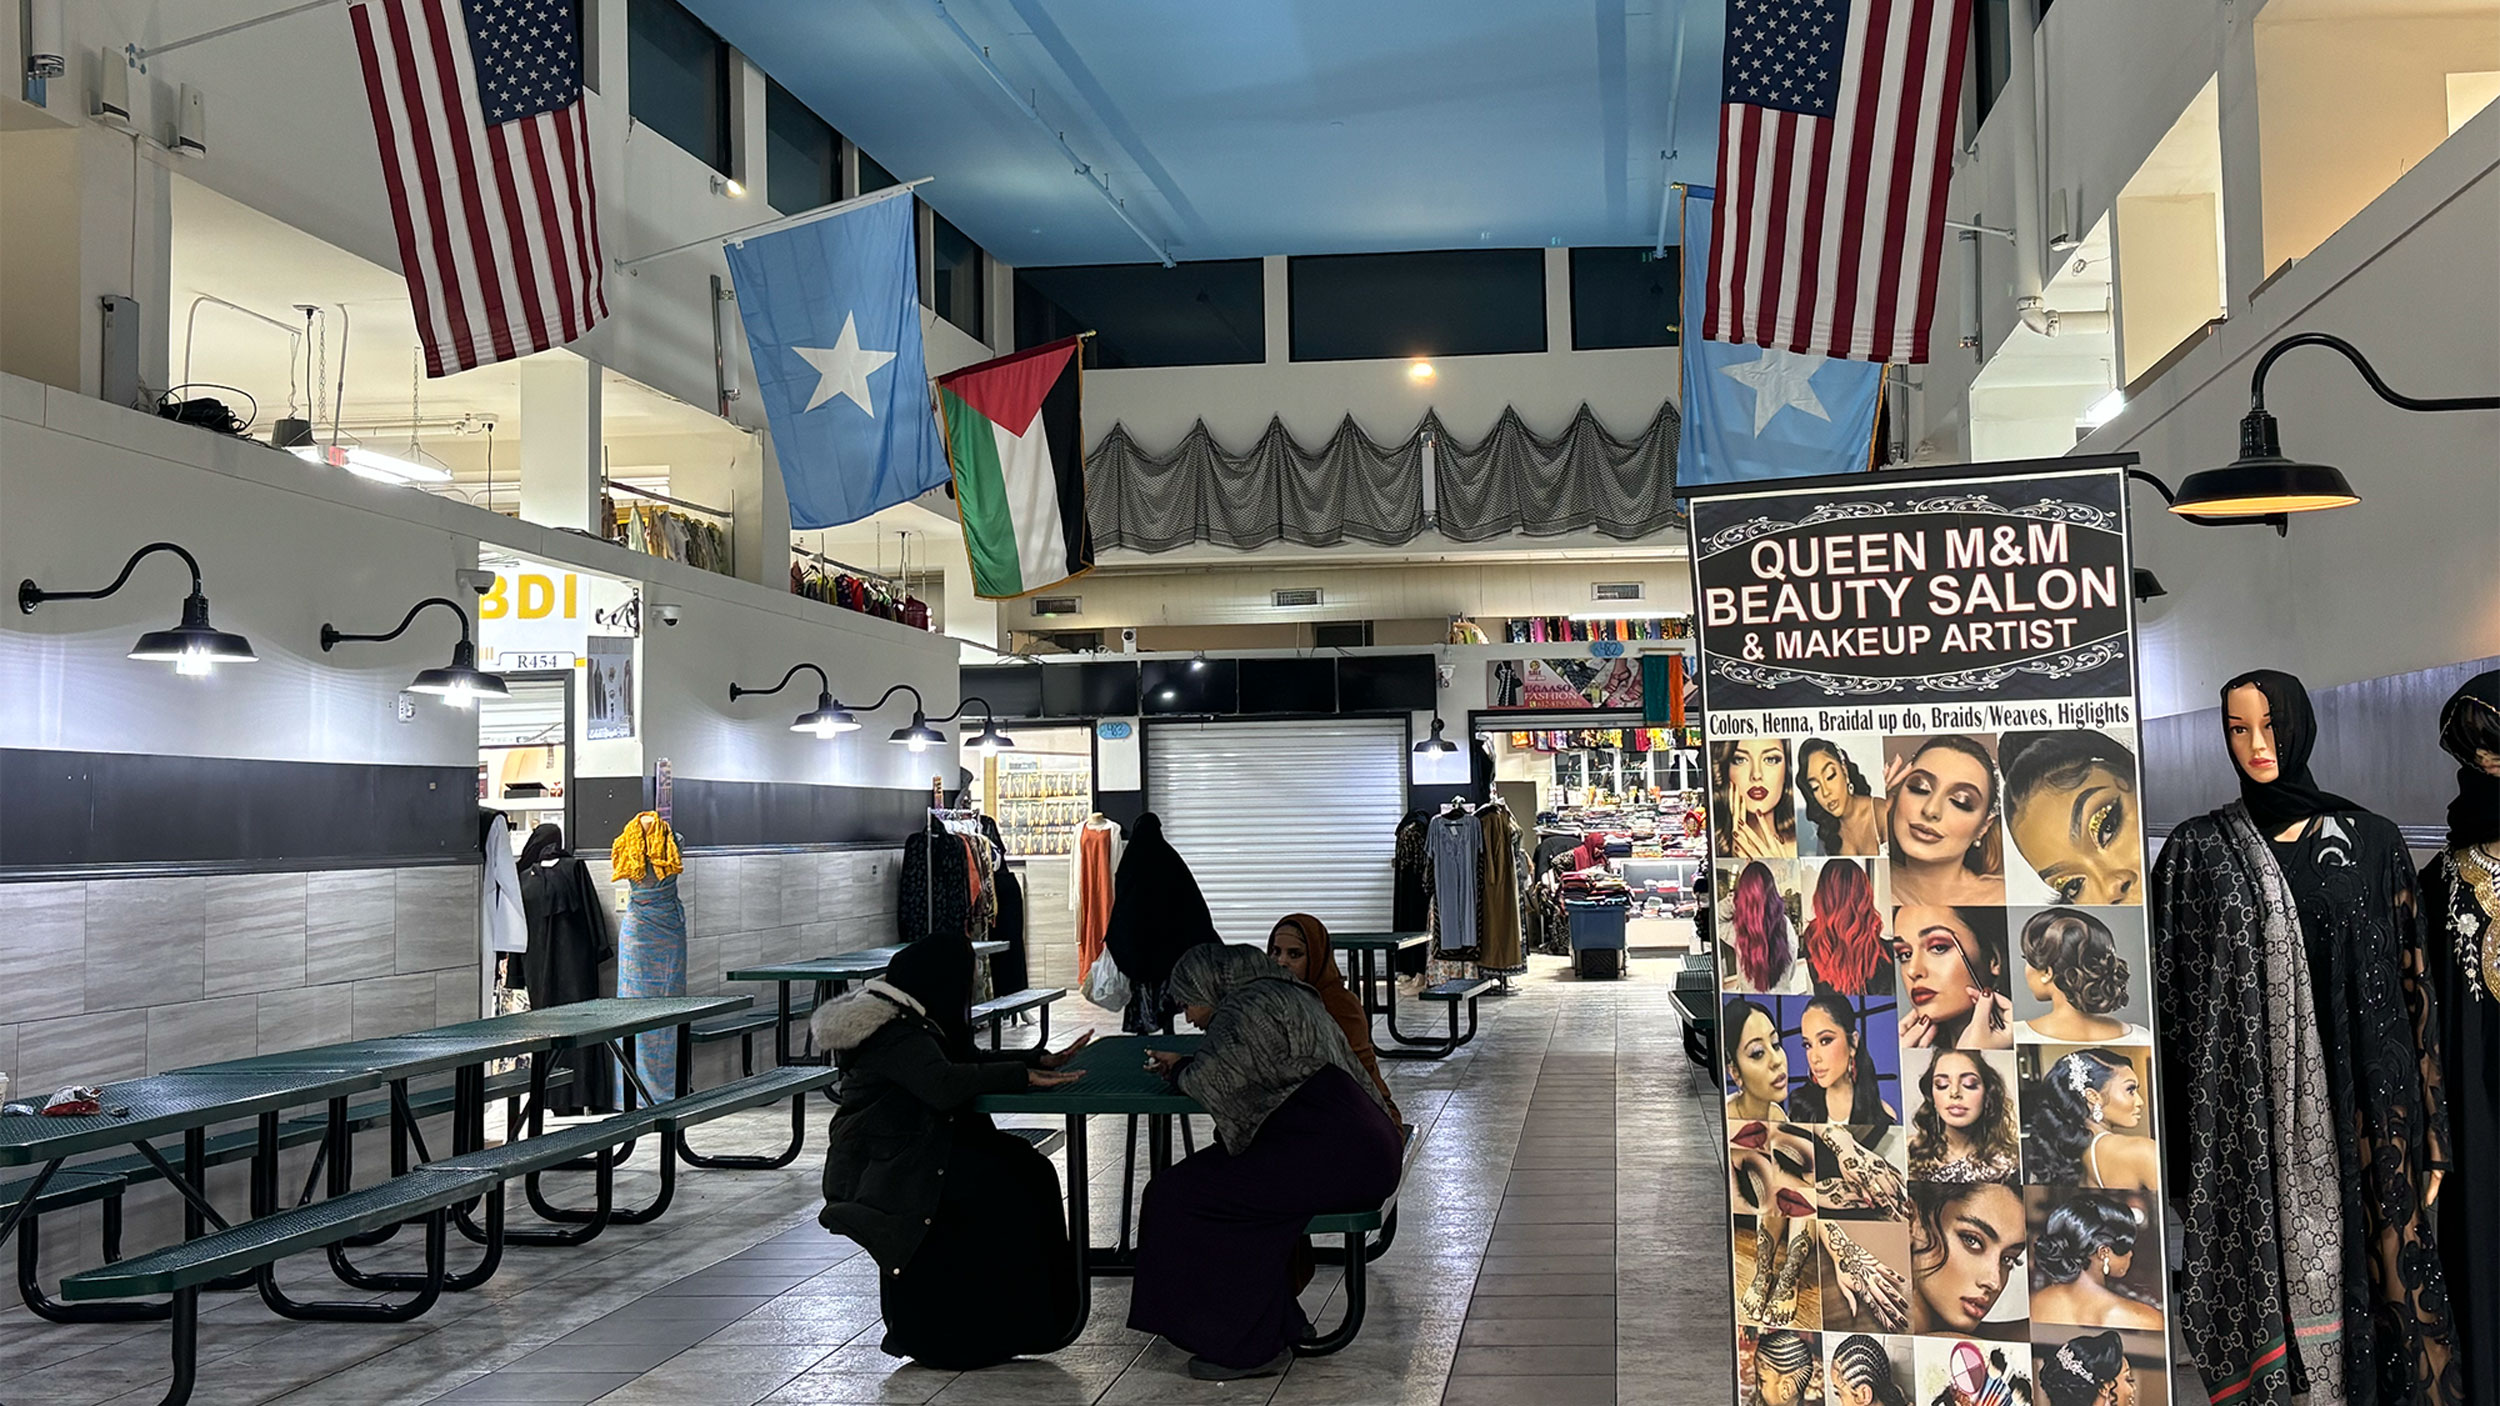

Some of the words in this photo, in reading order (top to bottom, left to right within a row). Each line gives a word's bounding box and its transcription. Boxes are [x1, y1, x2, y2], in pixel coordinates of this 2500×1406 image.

[1750, 531, 1927, 581] QUEEN
[1945, 522, 2069, 569] M&M
[1705, 576, 1914, 628] BEAUTY
[1928, 566, 2118, 615] SALON
[1741, 632, 1767, 662] &
[1775, 624, 1932, 660] MAKEUP
[1940, 618, 2079, 653] ARTIST
[517, 655, 557, 668] R454
[1524, 691, 1578, 700] FASHION
[1709, 713, 1759, 737] Colors,
[1762, 712, 1814, 736] Henna,
[1818, 709, 1874, 732] Braidal
[1879, 713, 1898, 734] up
[1903, 707, 1927, 732] do,
[2058, 701, 2130, 729] Higlights
